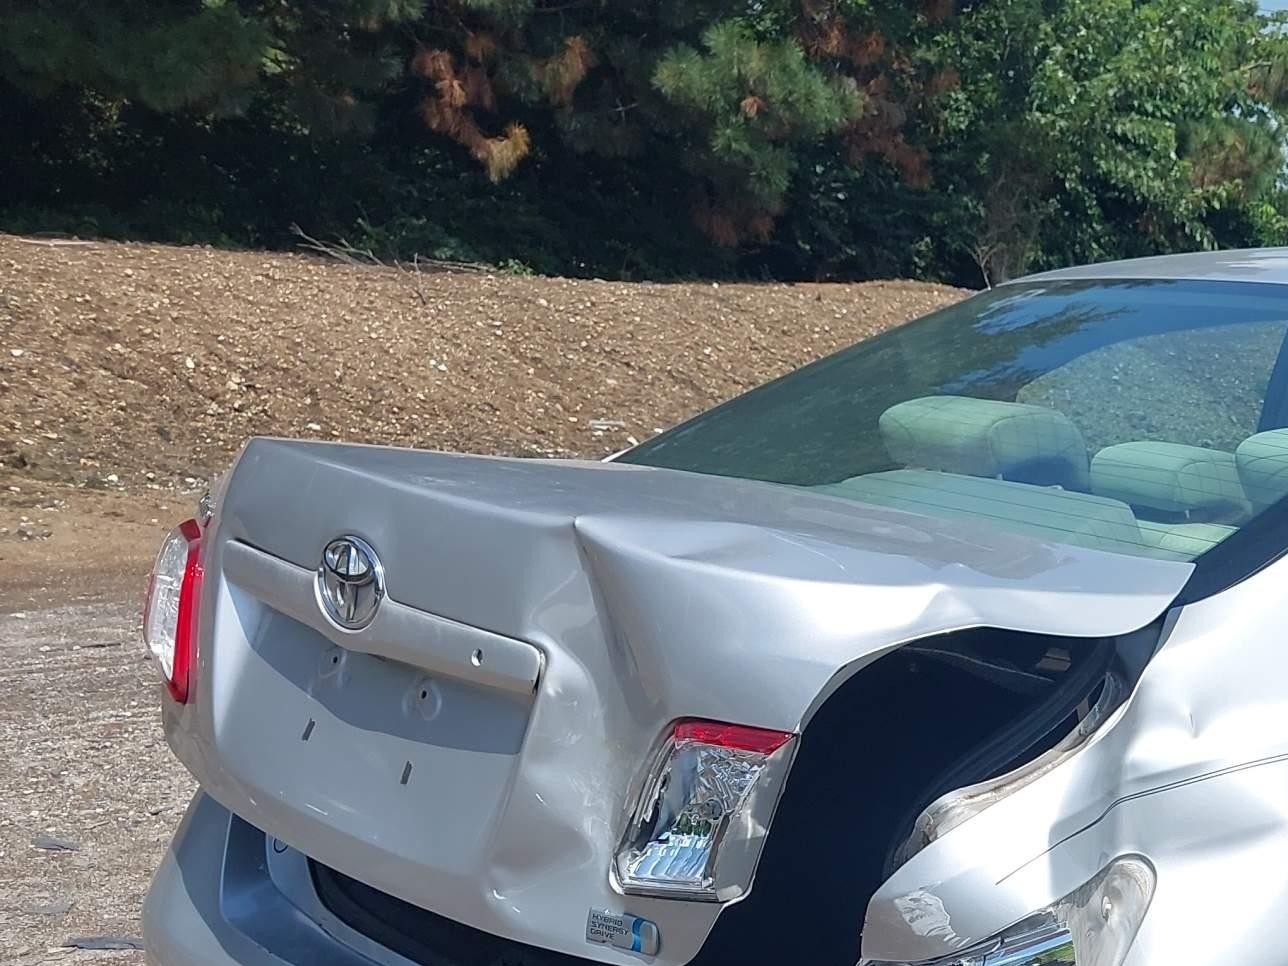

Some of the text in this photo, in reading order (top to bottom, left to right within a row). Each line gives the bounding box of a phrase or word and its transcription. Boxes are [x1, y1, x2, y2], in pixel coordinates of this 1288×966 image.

[592, 913, 623, 926] HYBRID
[590, 928, 615, 939] DRIVE
[591, 921, 628, 935] SYNERGY
